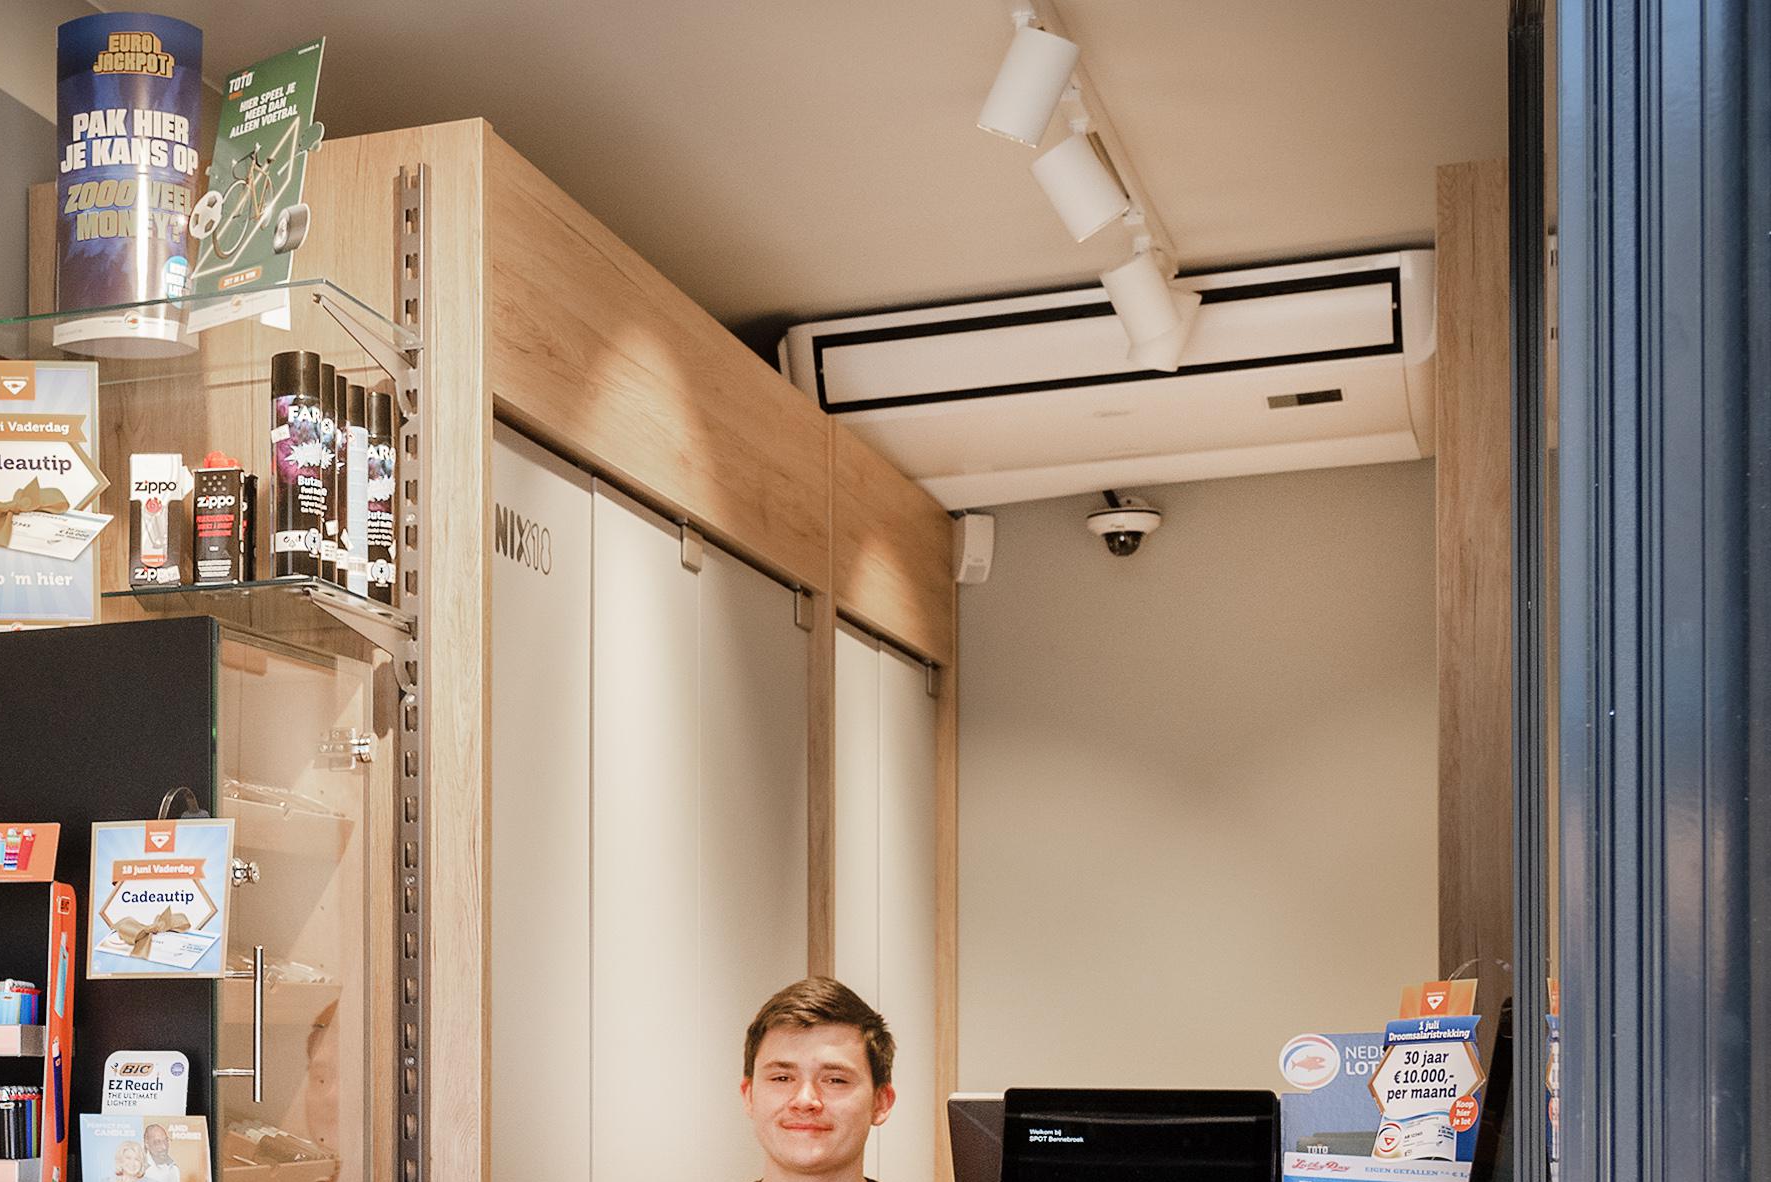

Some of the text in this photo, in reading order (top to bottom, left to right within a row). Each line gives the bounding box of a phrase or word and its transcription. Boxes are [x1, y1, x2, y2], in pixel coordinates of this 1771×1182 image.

[108, 33, 155, 54] EURO
[93, 53, 170, 76] JACKPOT
[229, 72, 255, 93] TOTO
[240, 82, 296, 112] HIER SPEEL JE
[245, 97, 287, 121] MEER DAN
[73, 109, 189, 143] PAK HIER
[229, 105, 298, 138] ALLEEN VOETBAL
[60, 137, 199, 175] JE KANS OP
[64, 179, 134, 213] ZOOO
[8, 422, 69, 434] Vaderdag
[135, 481, 176, 494] zippo
[197, 496, 235, 508] zippo
[496, 503, 551, 575] NIX18
[38, 572, 73, 585] hier
[122, 864, 195, 875] 18 juni Vaderdag
[122, 890, 194, 904] Cadeautip
[1389, 1029, 1470, 1042] Droomsalaristrekking
[1419, 1022, 1440, 1033] 1 juli
[1404, 1050, 1449, 1067] 30 jaar
[109, 1077, 163, 1091] EZ Reach
[1394, 1069, 1454, 1085] € 10.000,-
[1387, 1084, 1457, 1103] per maand
